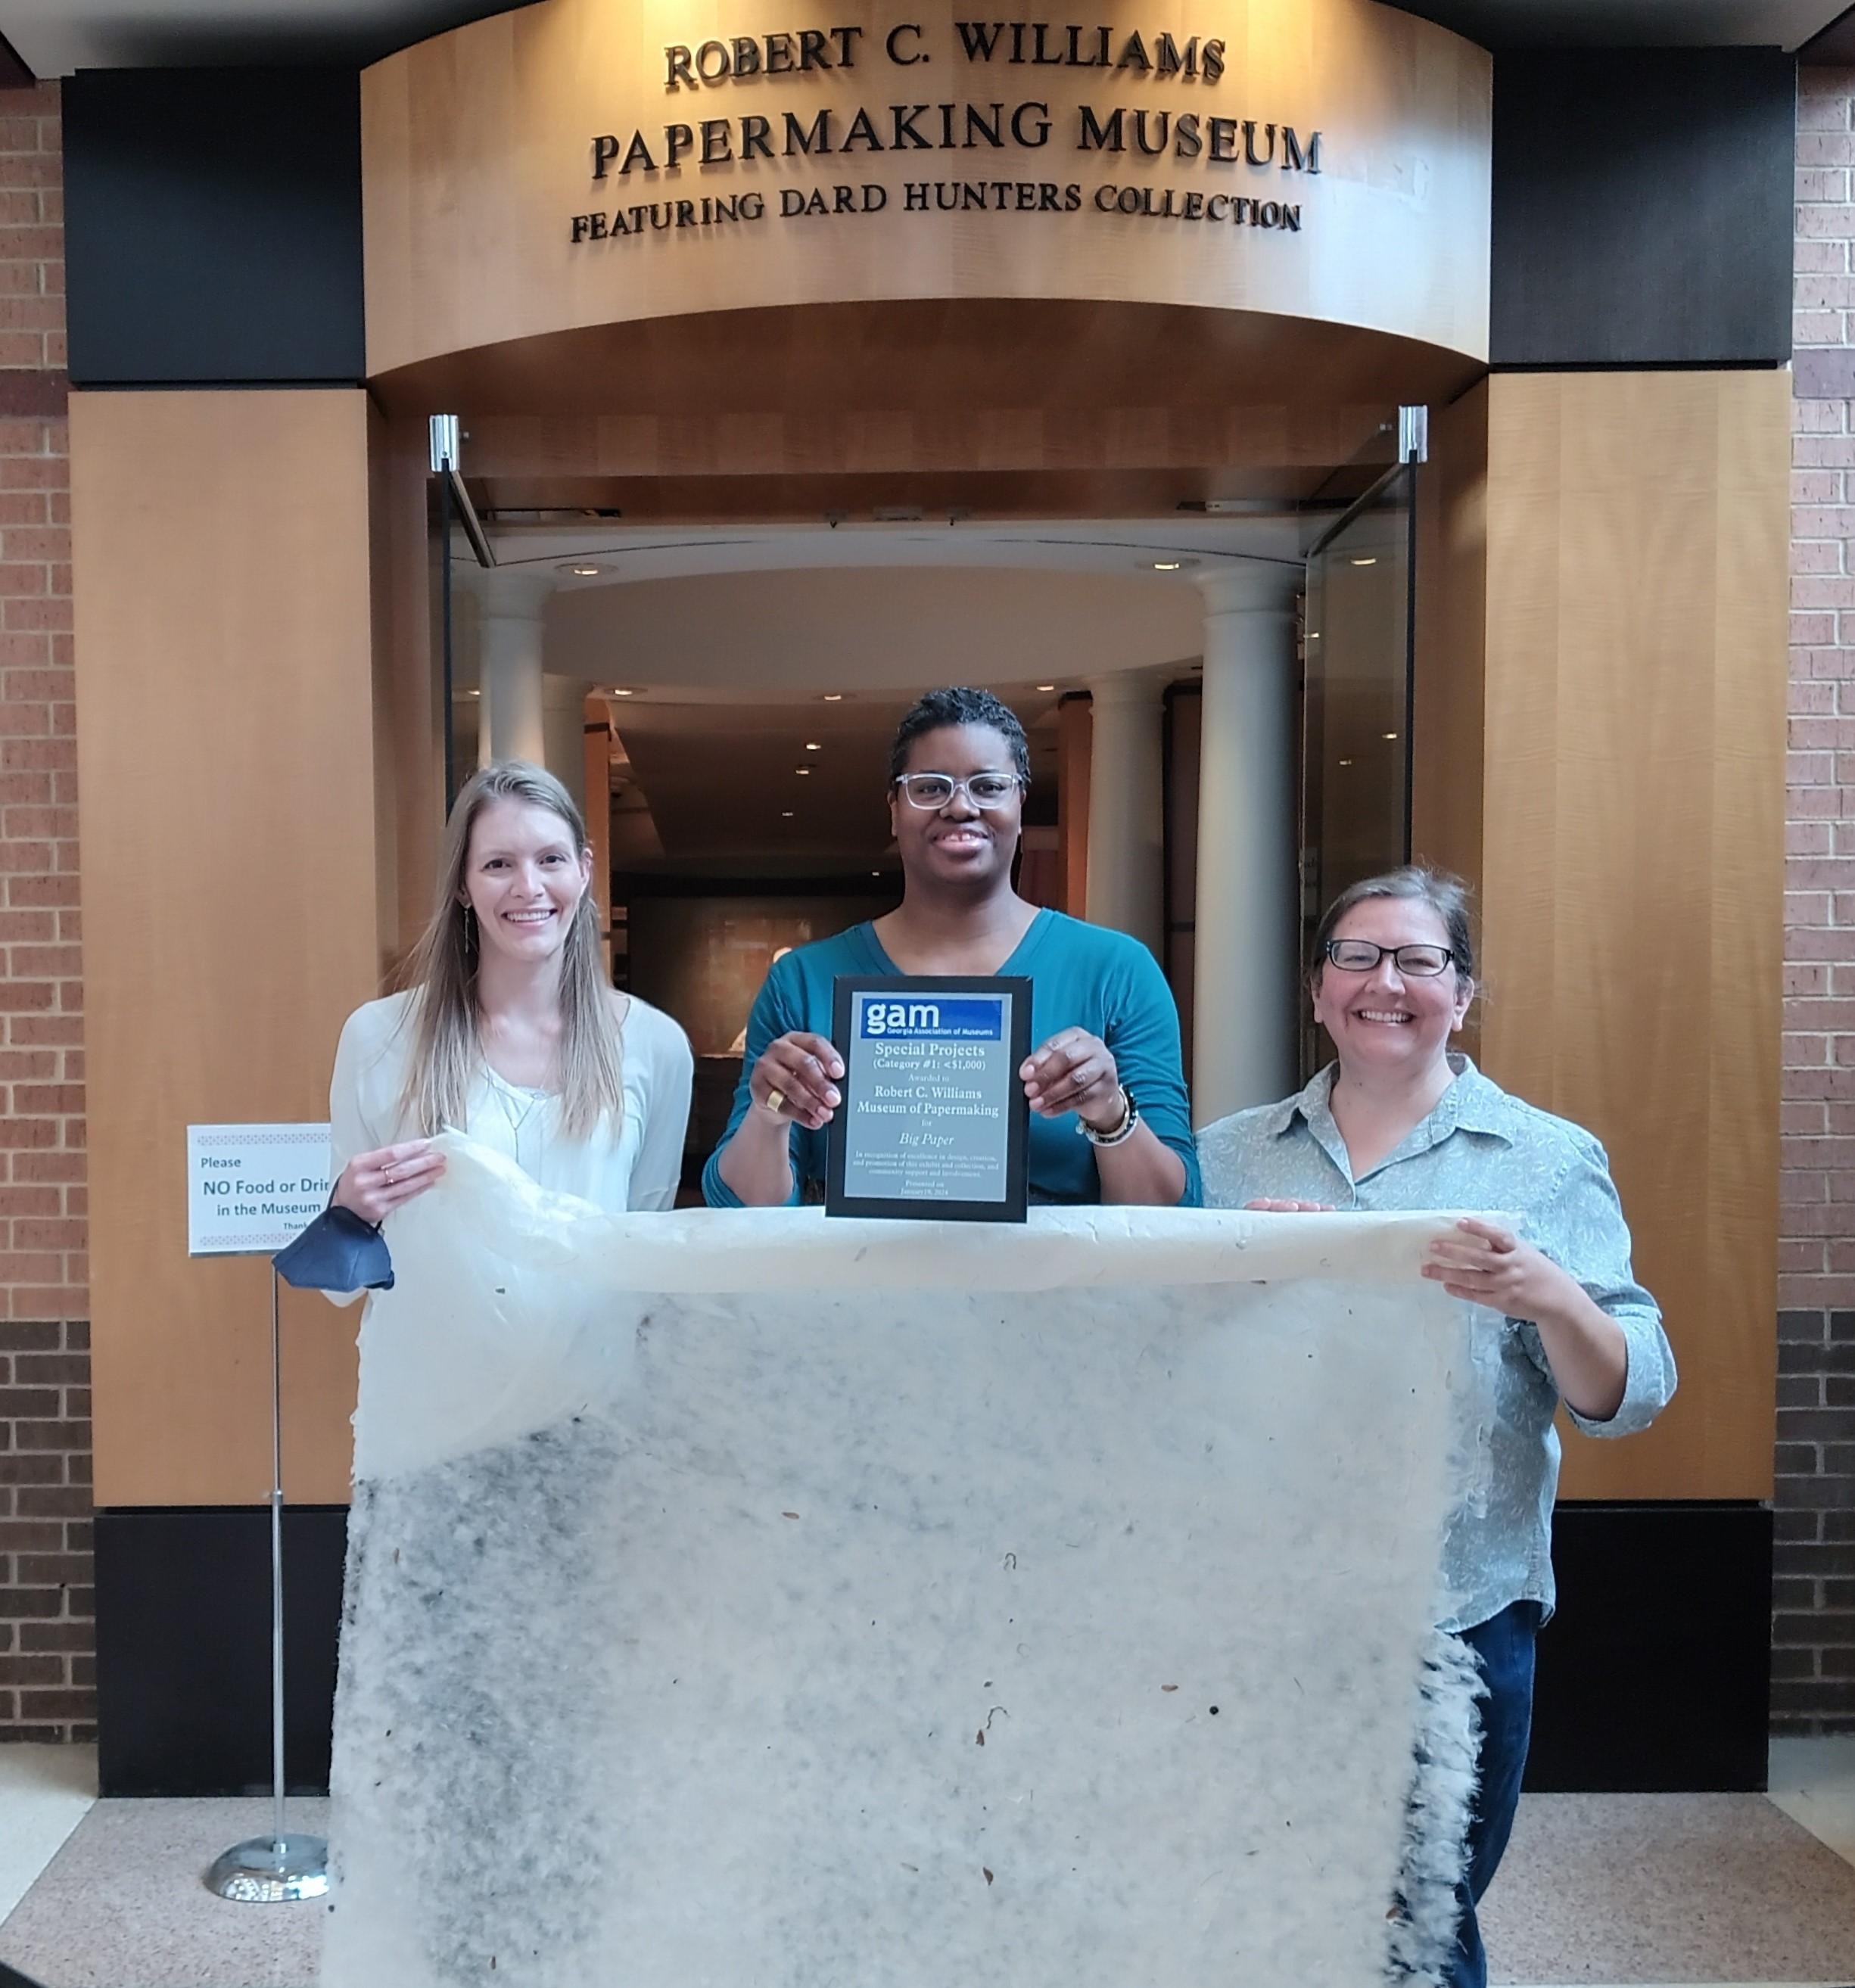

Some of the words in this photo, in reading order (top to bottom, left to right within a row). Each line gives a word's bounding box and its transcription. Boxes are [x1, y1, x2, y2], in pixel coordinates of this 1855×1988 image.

[664, 26, 863, 89] ROBERT
[885, 25, 929, 65] C.
[955, 21, 1225, 80] WILLIAMS
[591, 101, 1053, 179] PAPERMAKING
[1078, 105, 1322, 174] MUSEUM
[570, 191, 764, 243] FEATURING
[780, 185, 886, 217] DARD
[903, 182, 1082, 212] HUNTERS
[1094, 184, 1302, 232] COLLECTION
[867, 1003, 939, 1034] gam
[887, 1027, 912, 1035] Georgia
[875, 1043, 924, 1057] Special
[929, 1044, 985, 1057] Projects
[873, 1059, 920, 1070] (Category
[923, 1060, 941, 1069] #1:
[944, 1060, 985, 1071] <$1,000)
[908, 1074, 940, 1082] Awarded
[875, 1086, 912, 1097] Robert
[916, 1087, 928, 1097] C.
[932, 1087, 982, 1099] Williams
[857, 1101, 906, 1113] Museum
[910, 1103, 921, 1114] of
[924, 1104, 999, 1118] Papermaking
[899, 1133, 919, 1146] Big
[922, 1134, 954, 1147] Paper
[201, 1157, 241, 1168] Please
[204, 1181, 230, 1195] NO
[236, 1180, 274, 1194] Food
[279, 1182, 295, 1193] or
[217, 1205, 229, 1216] in
[235, 1204, 257, 1215] the
[262, 1203, 320, 1215] Museum
